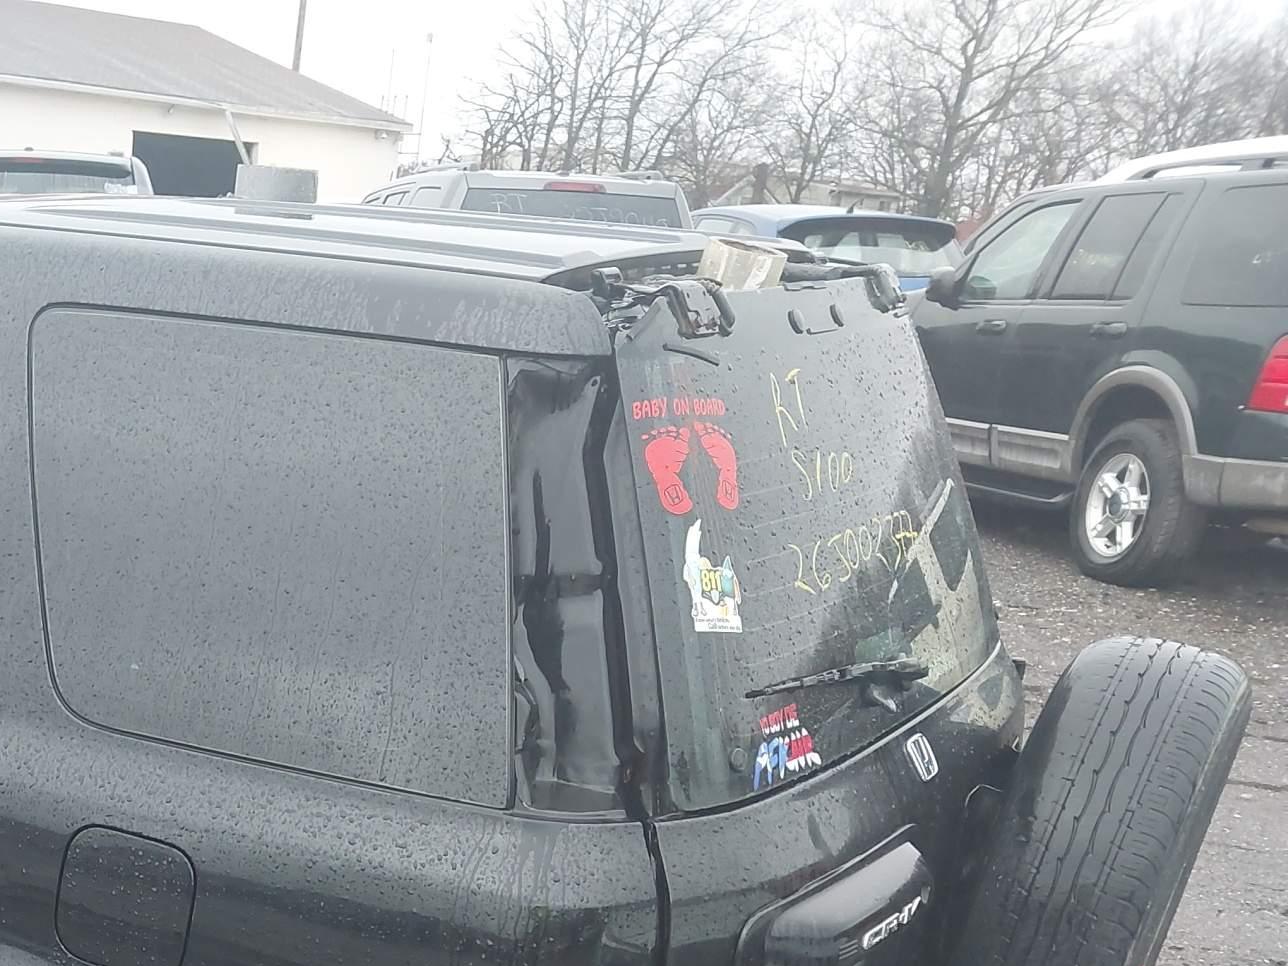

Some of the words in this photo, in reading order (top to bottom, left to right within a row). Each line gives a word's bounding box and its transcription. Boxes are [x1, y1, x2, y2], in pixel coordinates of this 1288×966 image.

[632, 396, 667, 419] BABY
[673, 398, 689, 416] ON
[693, 398, 725, 416] BOARD
[770, 368, 809, 447] RT
[701, 569, 723, 592] 811
